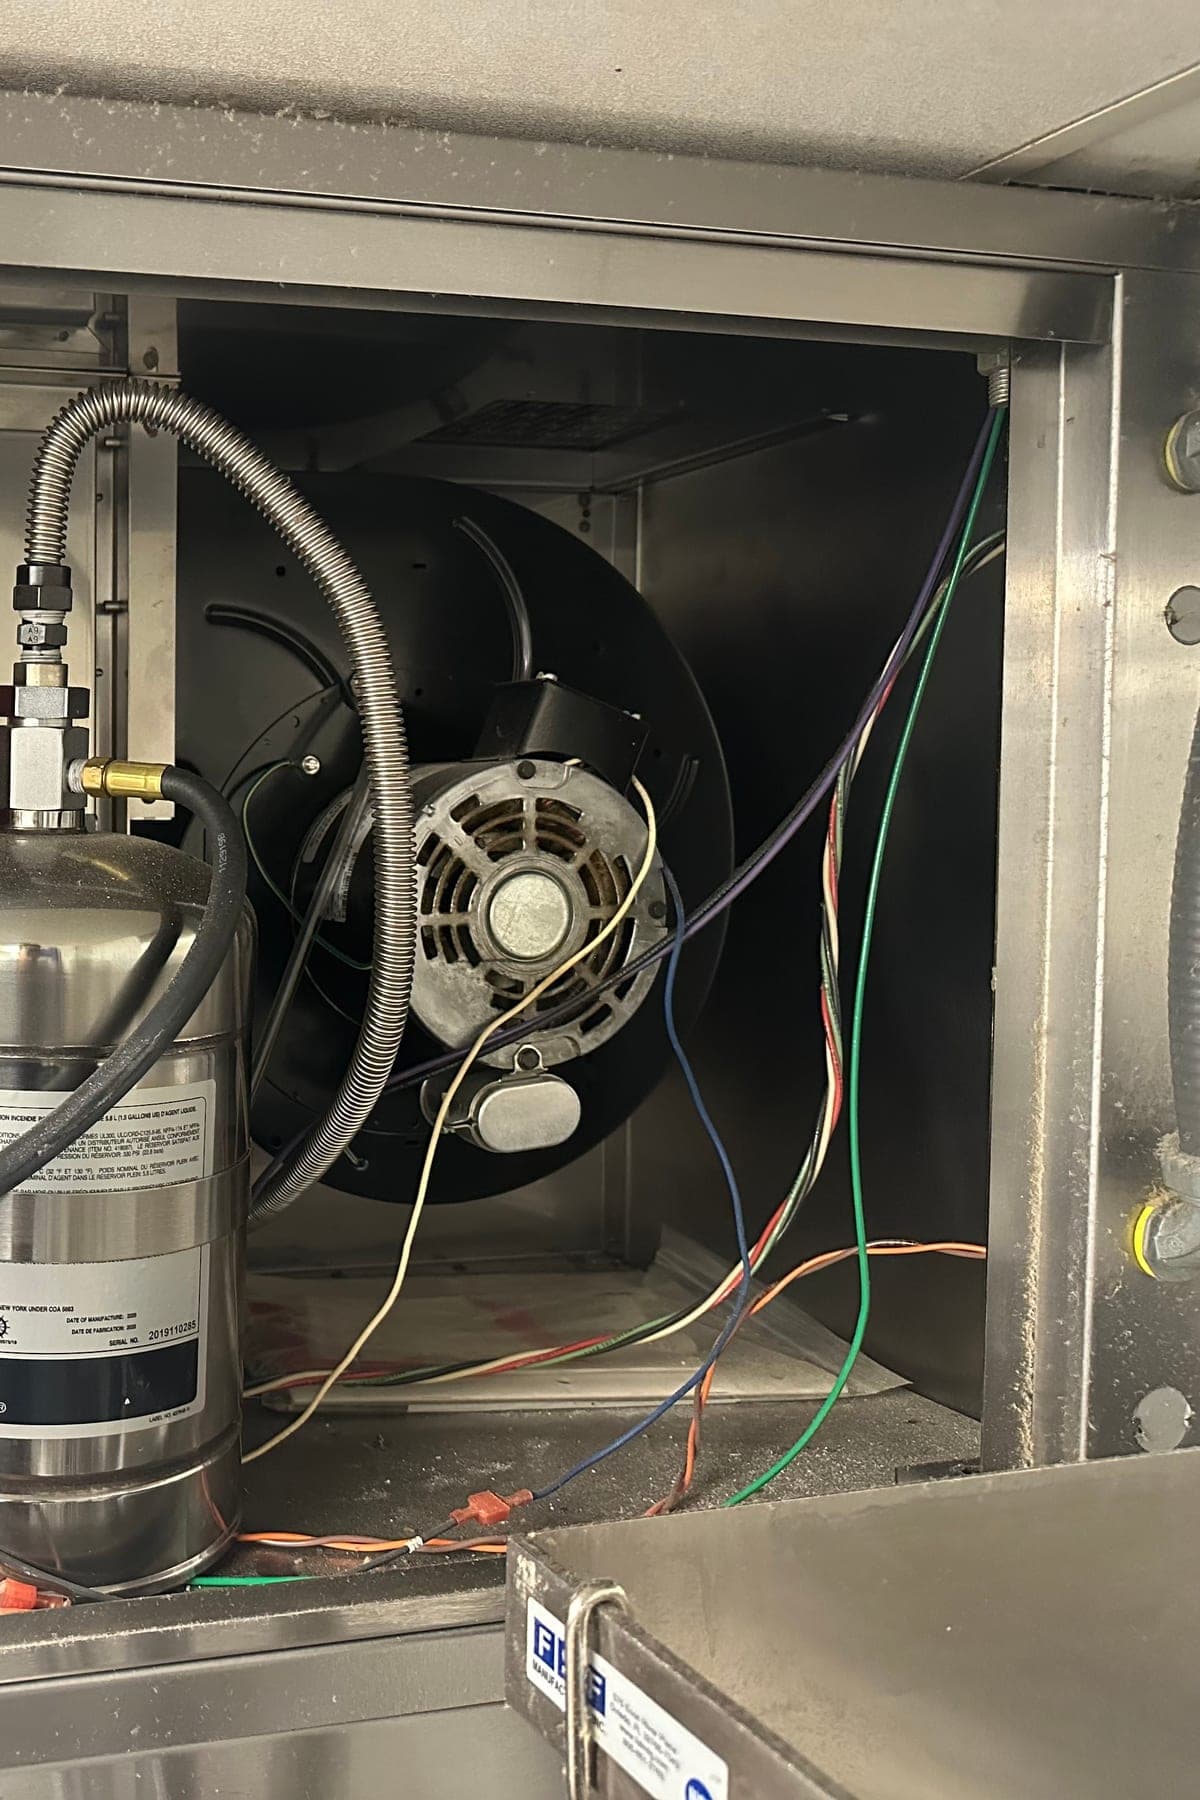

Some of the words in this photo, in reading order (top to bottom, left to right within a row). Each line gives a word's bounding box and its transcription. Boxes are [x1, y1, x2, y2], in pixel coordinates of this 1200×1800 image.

[12, 1304, 28, 1312] YORK
[109, 1338, 128, 1347] SERIAL
[148, 1319, 197, 1341] 2019110285
[532, 1659, 566, 1697] MANUFAC
